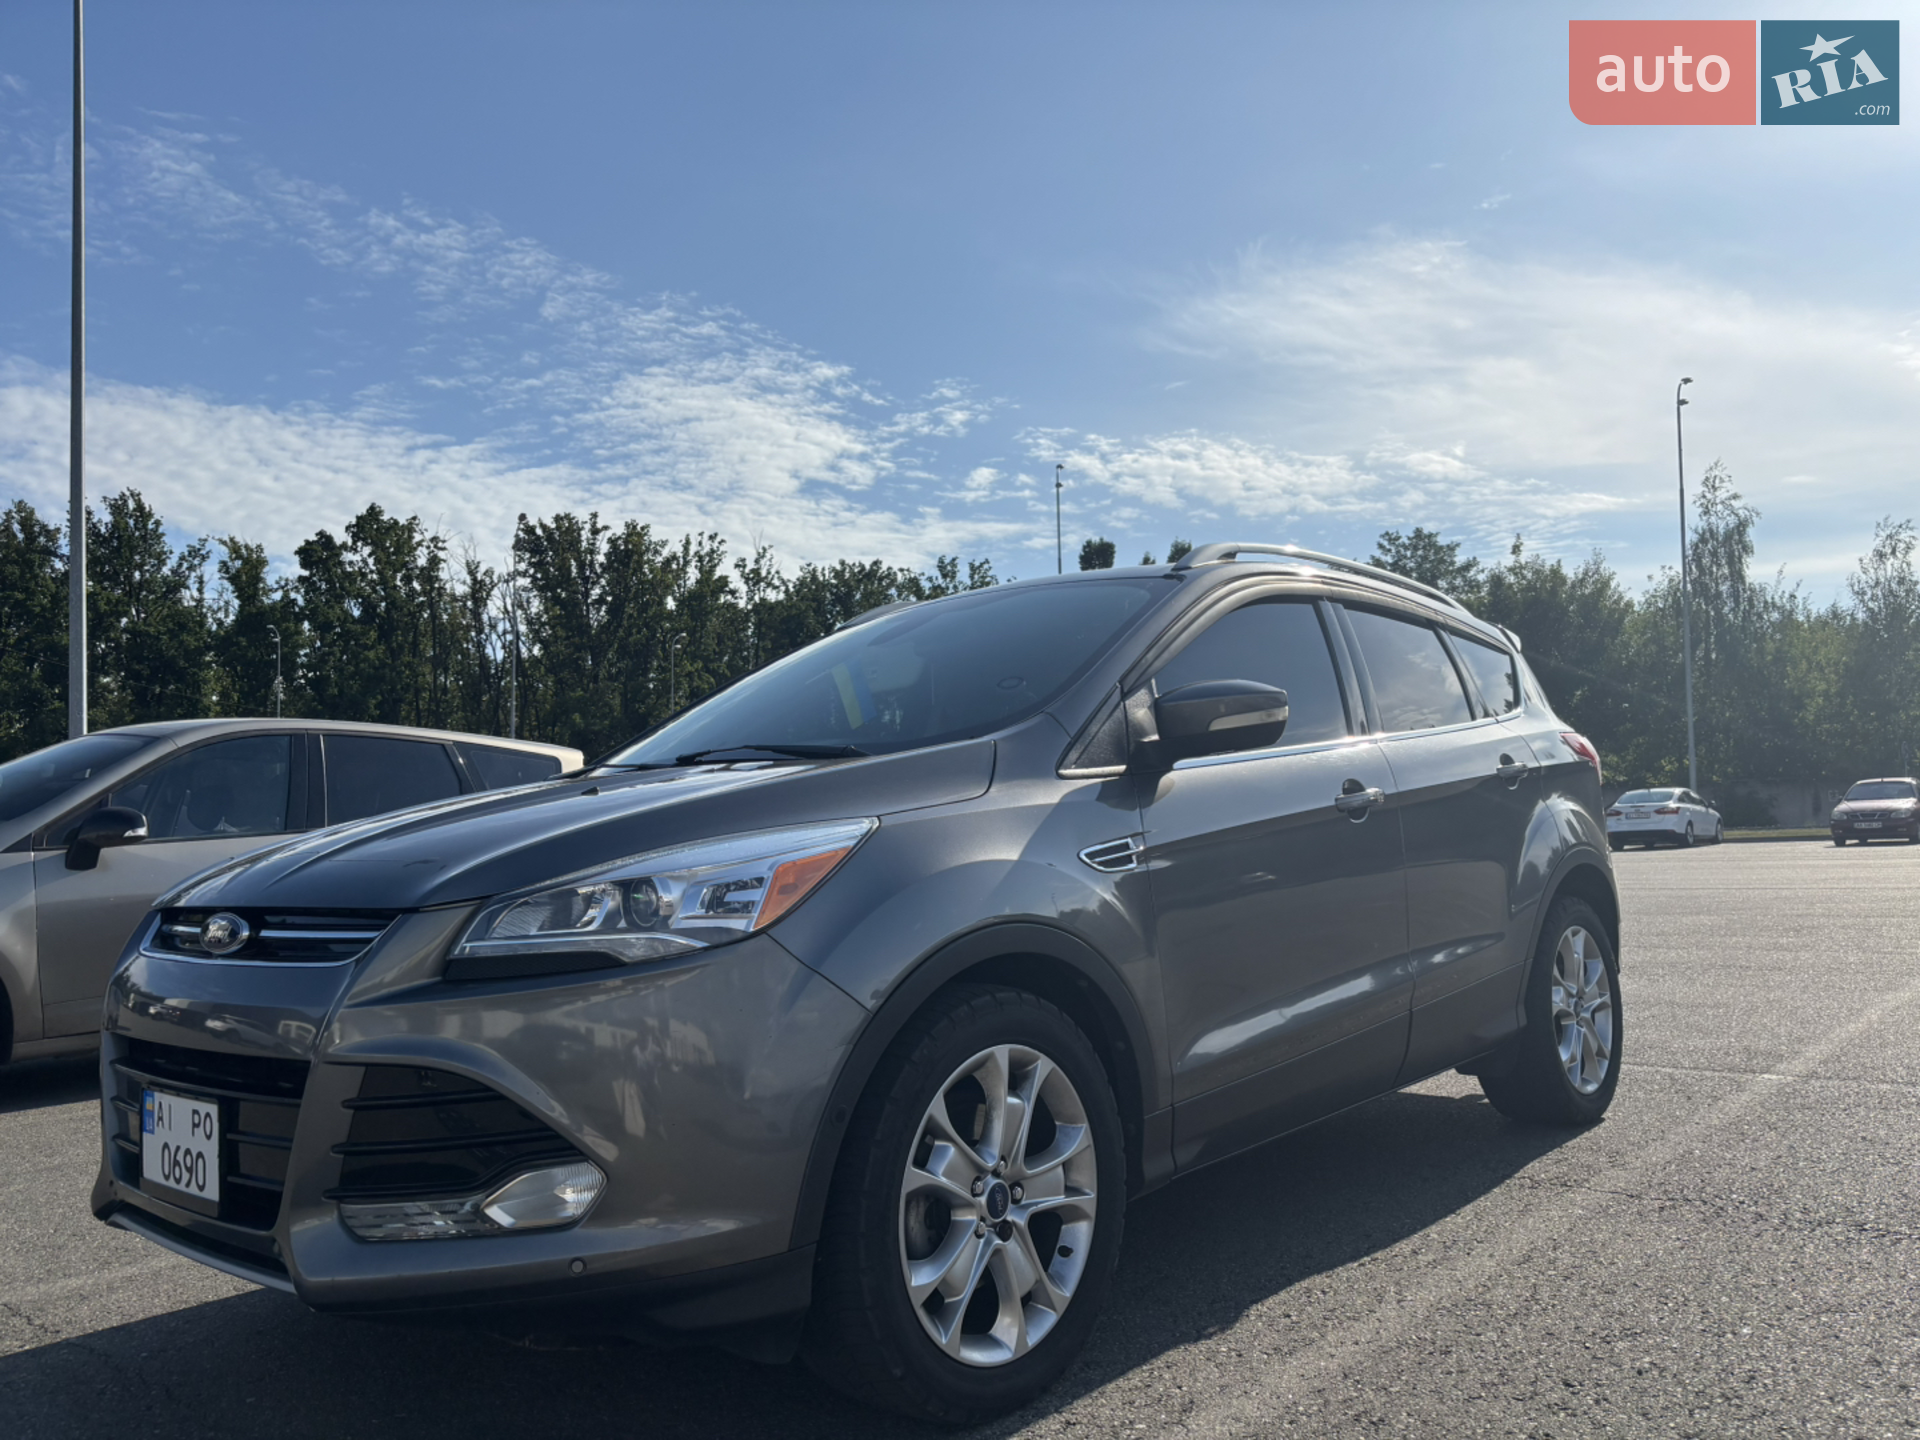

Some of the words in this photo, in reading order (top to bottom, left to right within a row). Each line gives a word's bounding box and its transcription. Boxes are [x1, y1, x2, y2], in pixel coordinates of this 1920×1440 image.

[156, 1101, 172, 1131] AI
[192, 1109, 213, 1141] PO
[161, 1142, 206, 1193] 0690
